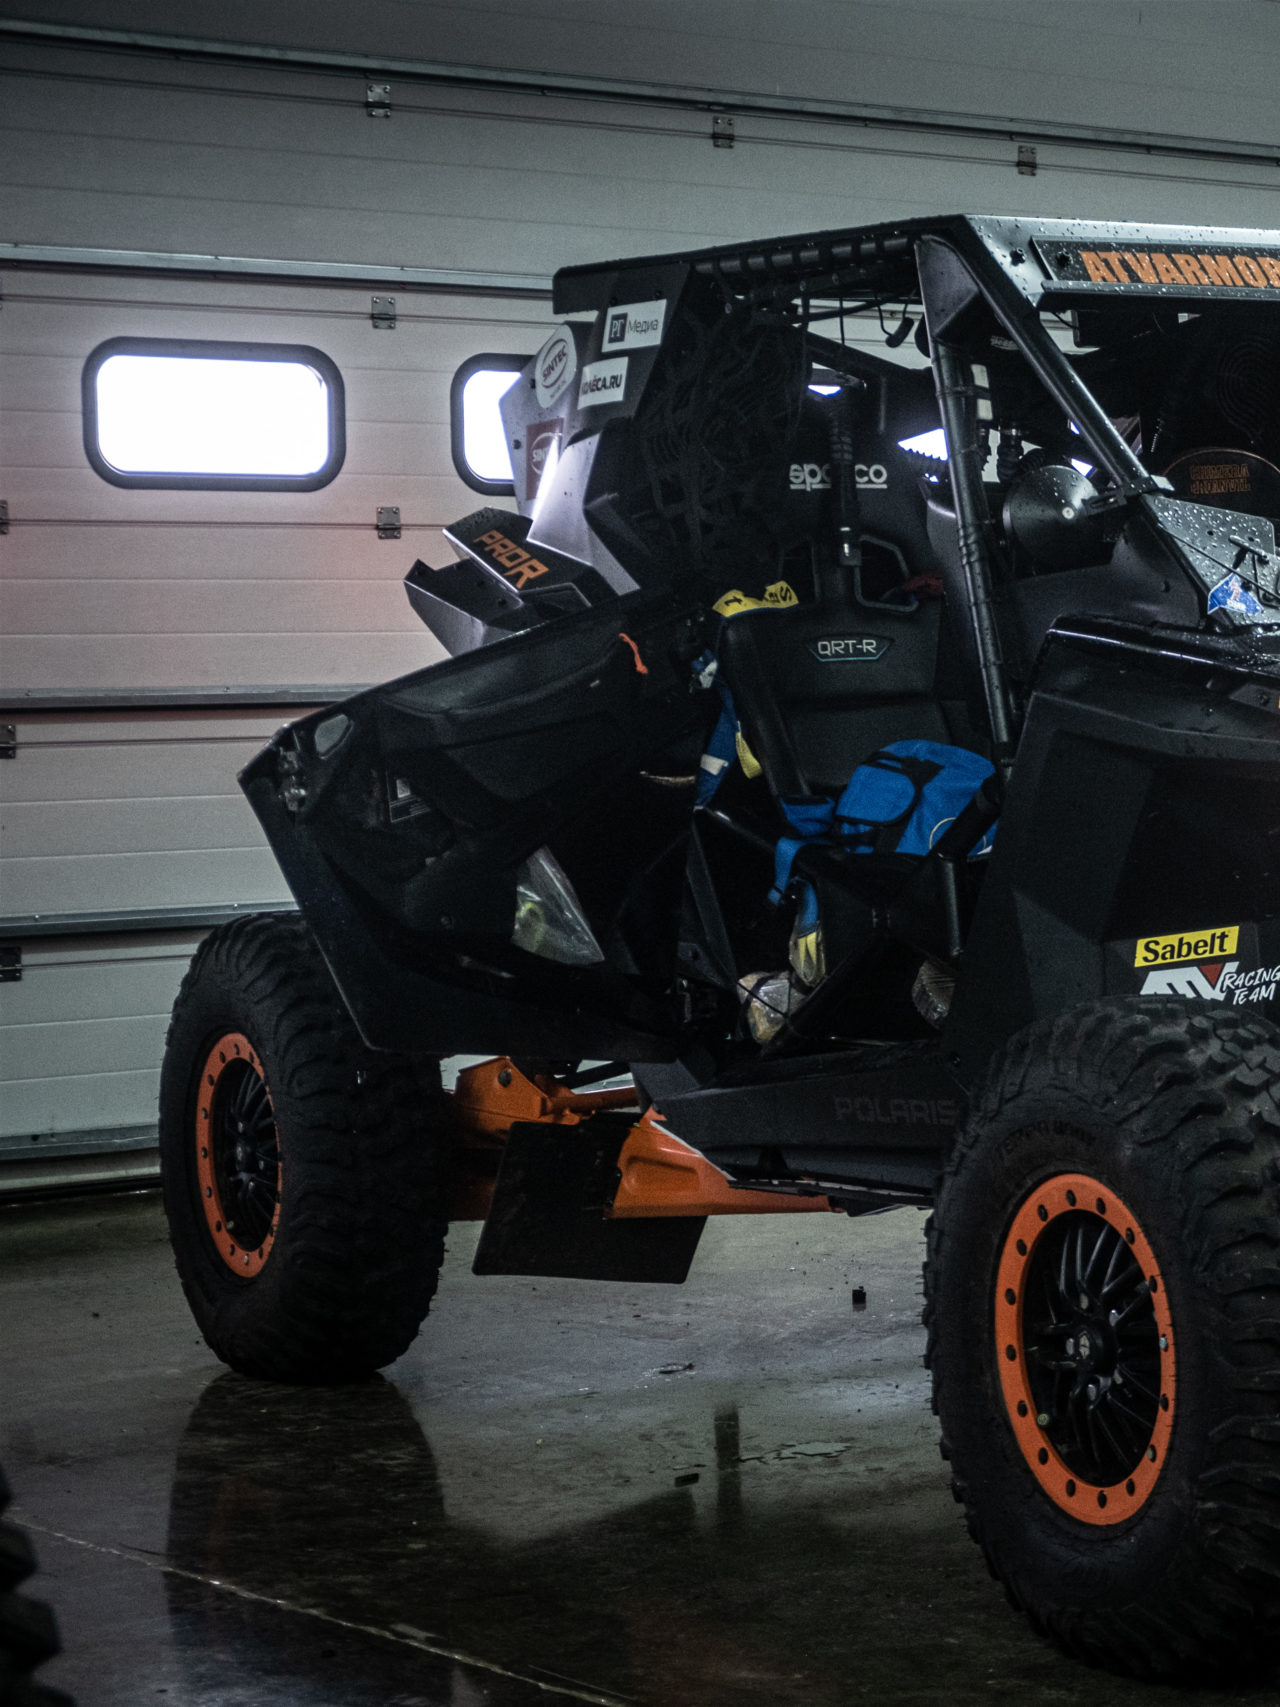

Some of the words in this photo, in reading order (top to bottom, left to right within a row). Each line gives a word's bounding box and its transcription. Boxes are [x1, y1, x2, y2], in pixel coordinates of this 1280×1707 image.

[627, 318, 659, 334] Медиа
[542, 345, 568, 382] SINTEC
[789, 463, 888, 491] spco
[818, 639, 877, 656] QRT-R
[1142, 931, 1230, 963] Sabelt
[1232, 983, 1277, 1006] TEAM
